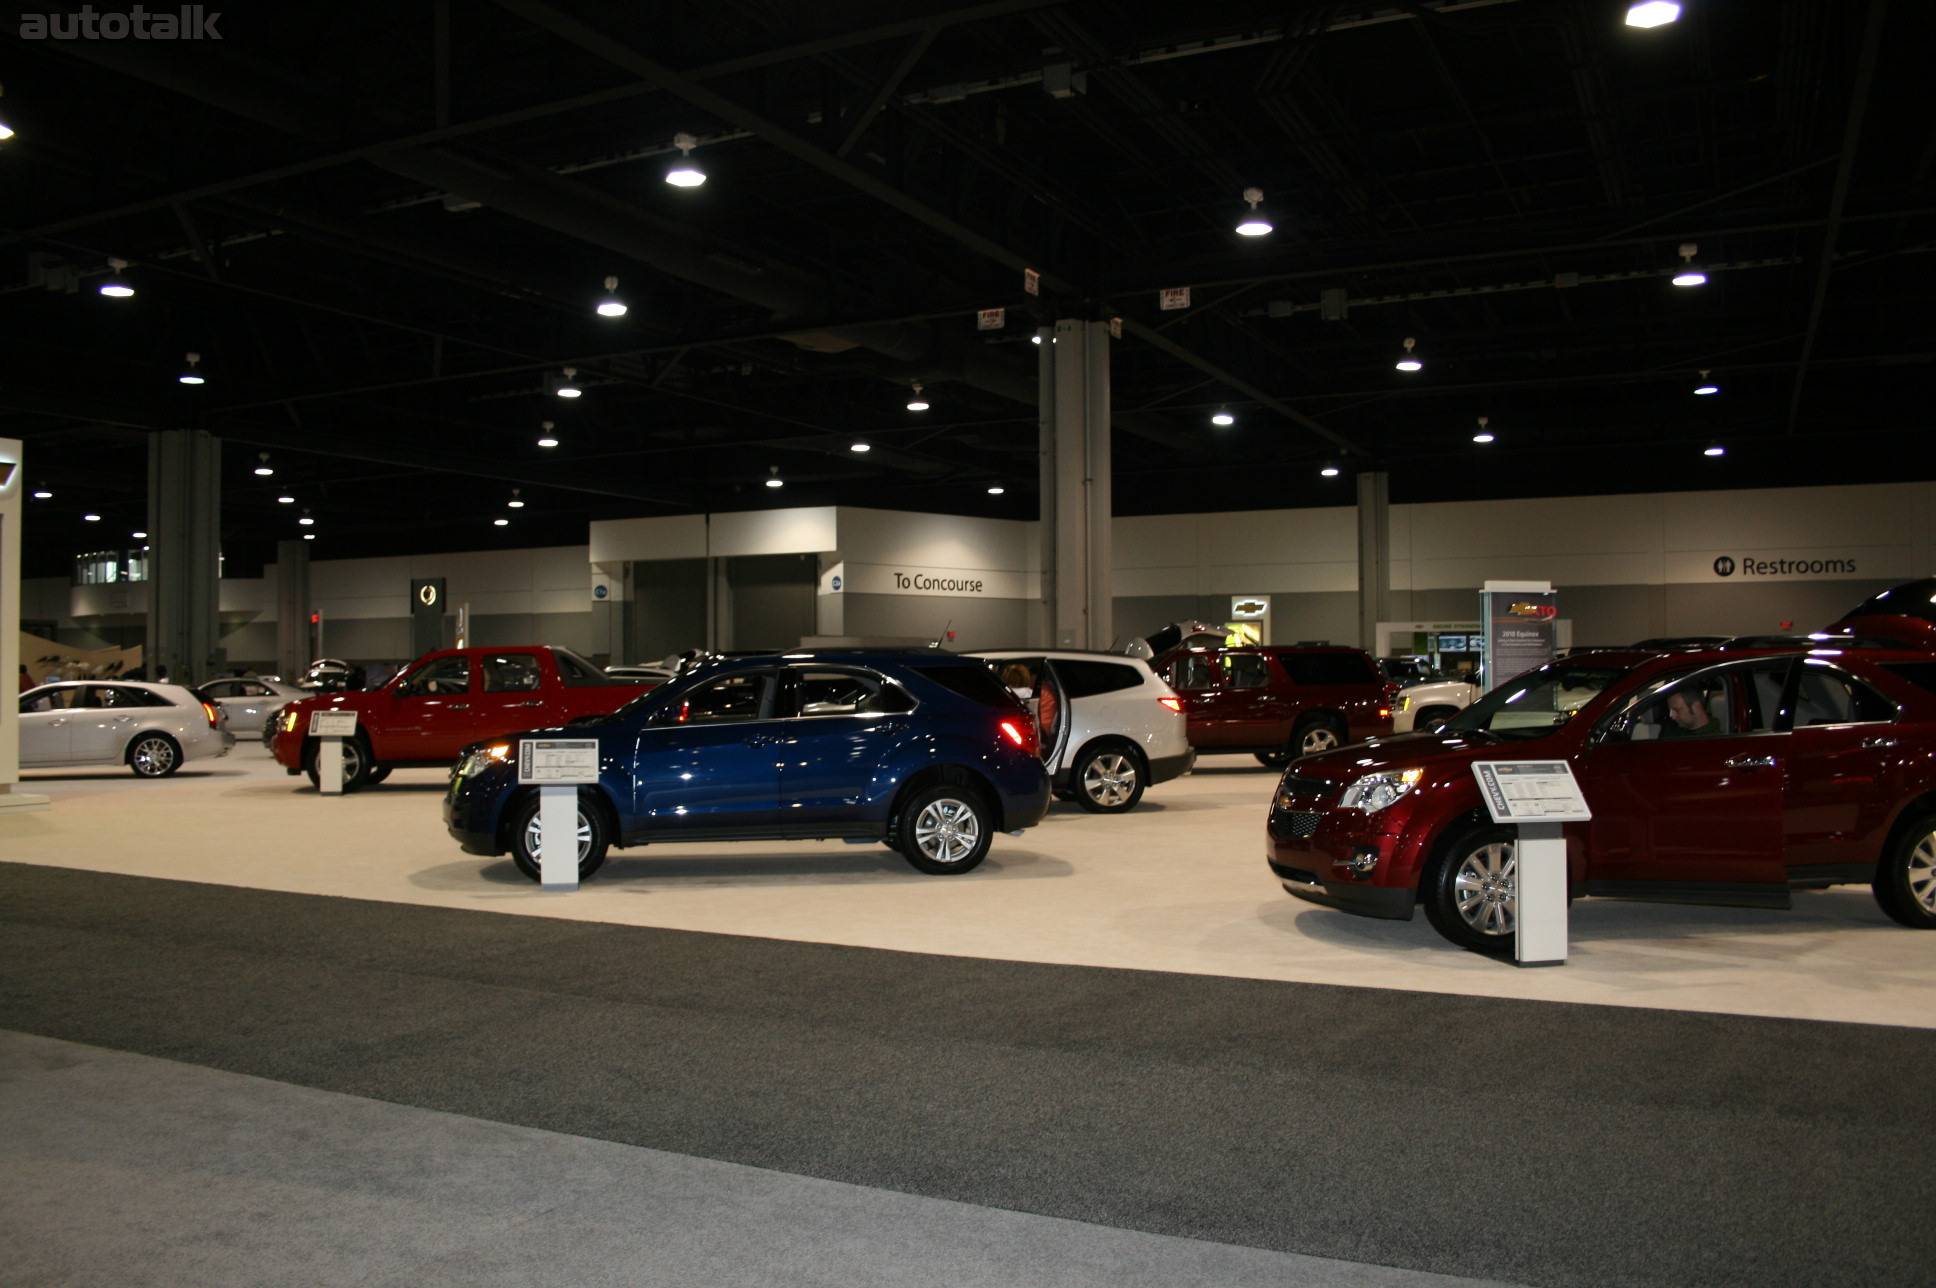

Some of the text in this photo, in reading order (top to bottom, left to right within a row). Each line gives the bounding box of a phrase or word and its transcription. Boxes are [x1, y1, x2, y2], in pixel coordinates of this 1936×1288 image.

[1165, 289, 1185, 297] FIRE
[982, 311, 1000, 319] FIRE
[1743, 557, 1857, 575] Restrooms
[893, 572, 983, 593] To Concourse
[1502, 630, 1539, 639] 2010 Equinox
[1482, 770, 1505, 810] CHEVY.COM
